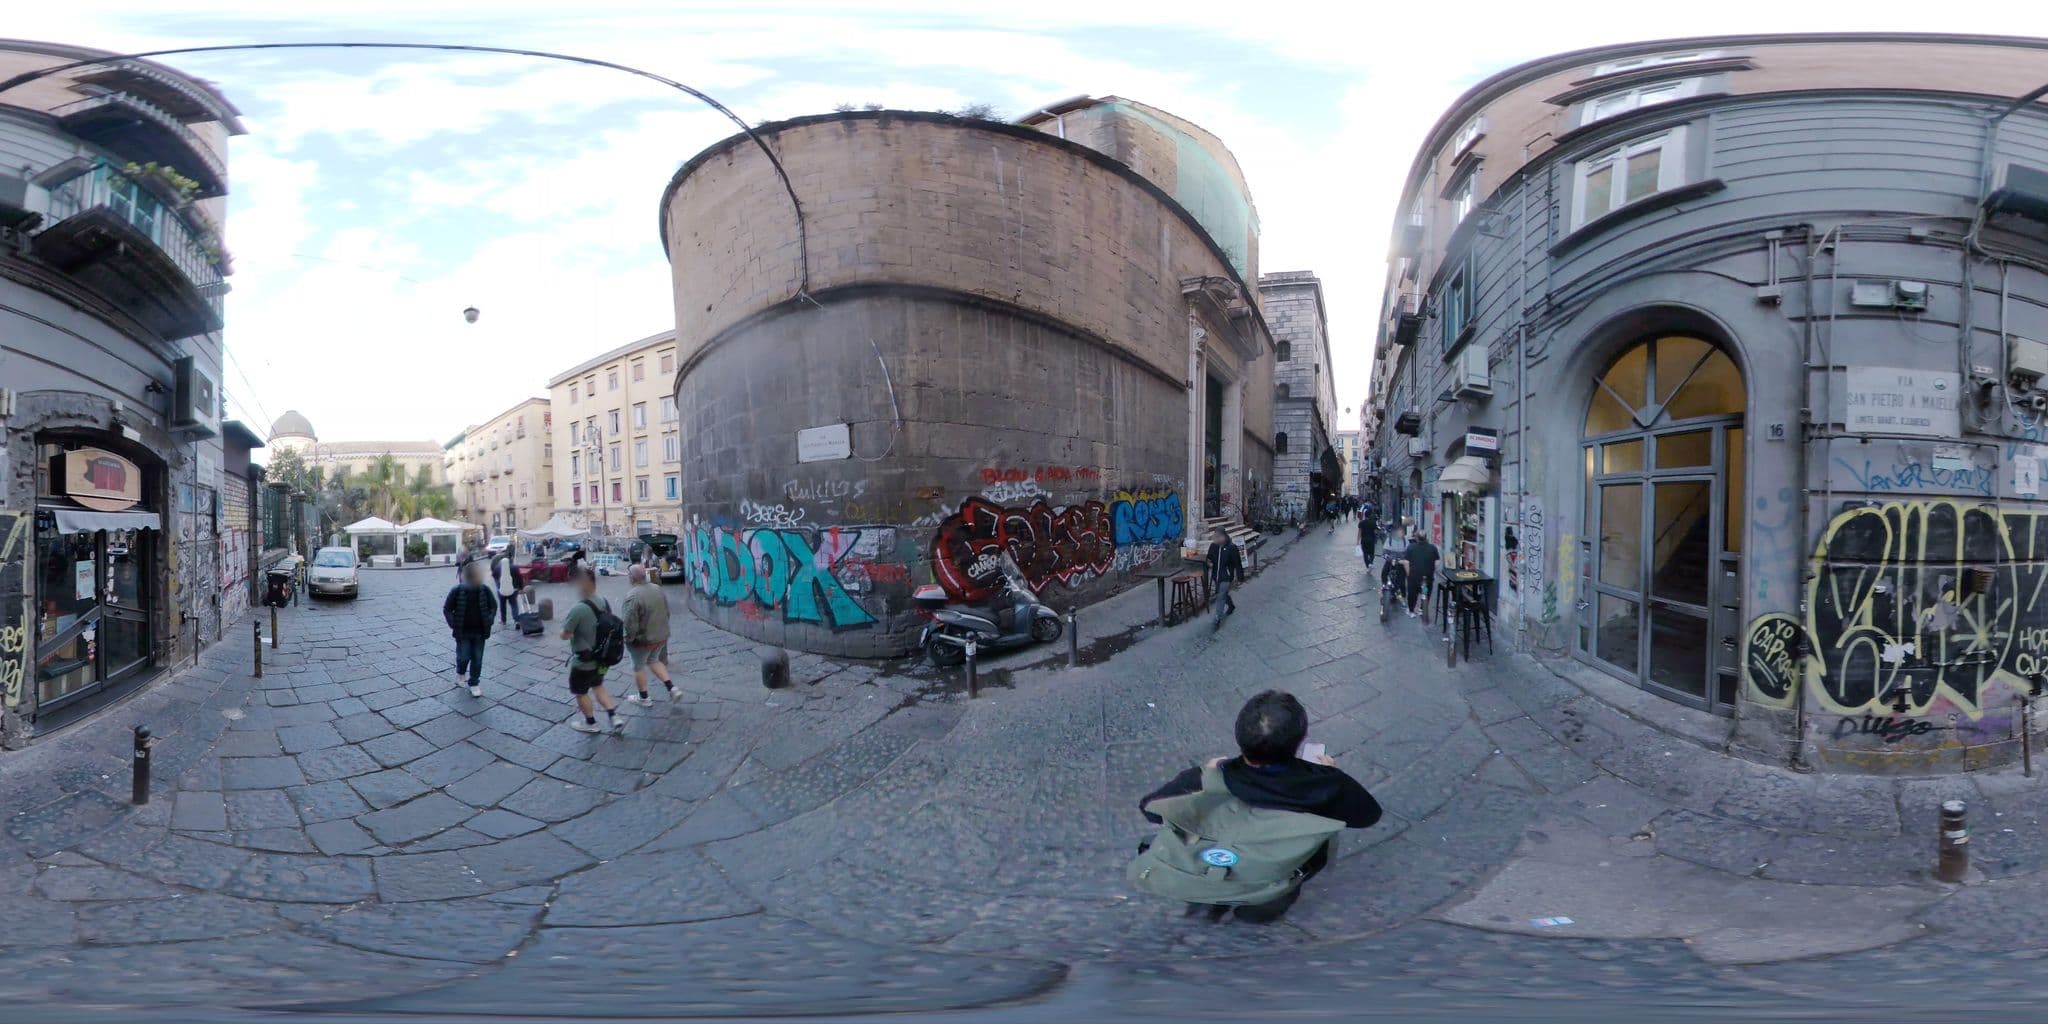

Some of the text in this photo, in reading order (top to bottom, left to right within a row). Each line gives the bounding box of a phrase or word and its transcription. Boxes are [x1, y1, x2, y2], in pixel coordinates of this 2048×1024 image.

[1897, 375, 1914, 387] VIA
[1847, 392, 1866, 406] SAN
[1871, 392, 1904, 408] PIETRO
[1909, 393, 1916, 408] A
[1770, 423, 1784, 437] 16
